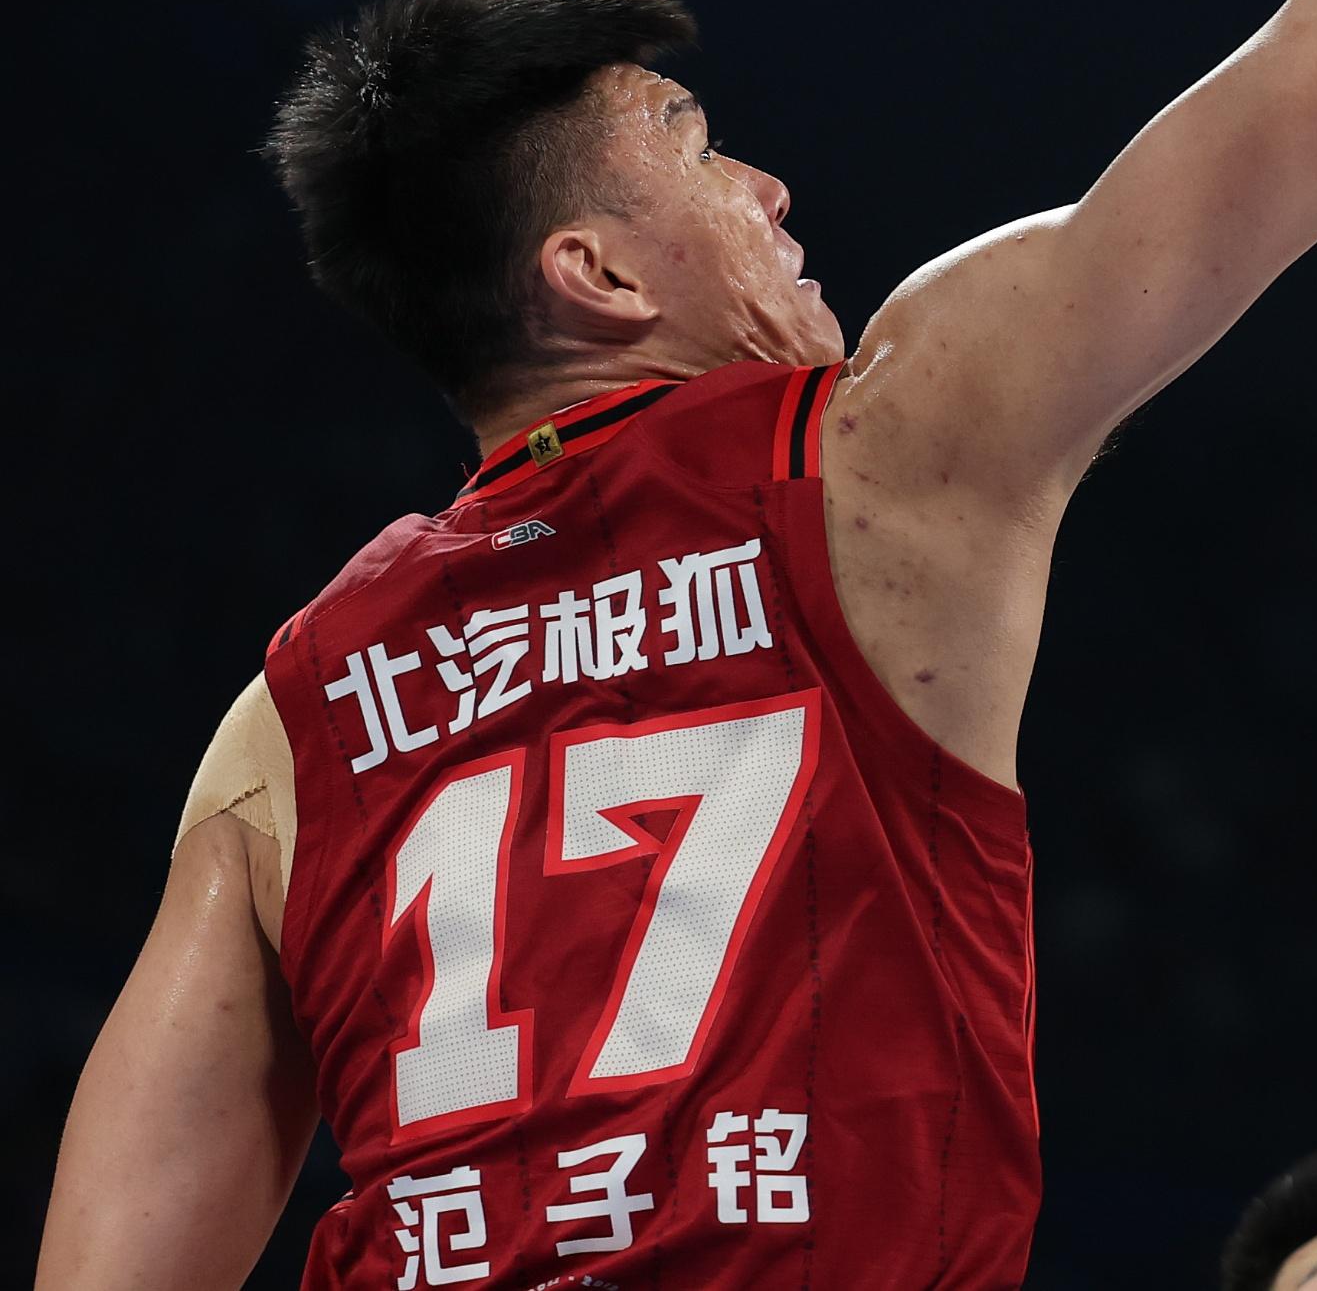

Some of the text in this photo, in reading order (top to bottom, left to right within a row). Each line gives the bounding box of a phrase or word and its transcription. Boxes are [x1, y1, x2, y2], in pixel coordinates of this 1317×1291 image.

[491, 520, 557, 550] CBA
[324, 538, 773, 774] 北汽极狐
[382, 688, 821, 1146] 17
[386, 1109, 810, 1291] 范子铭
